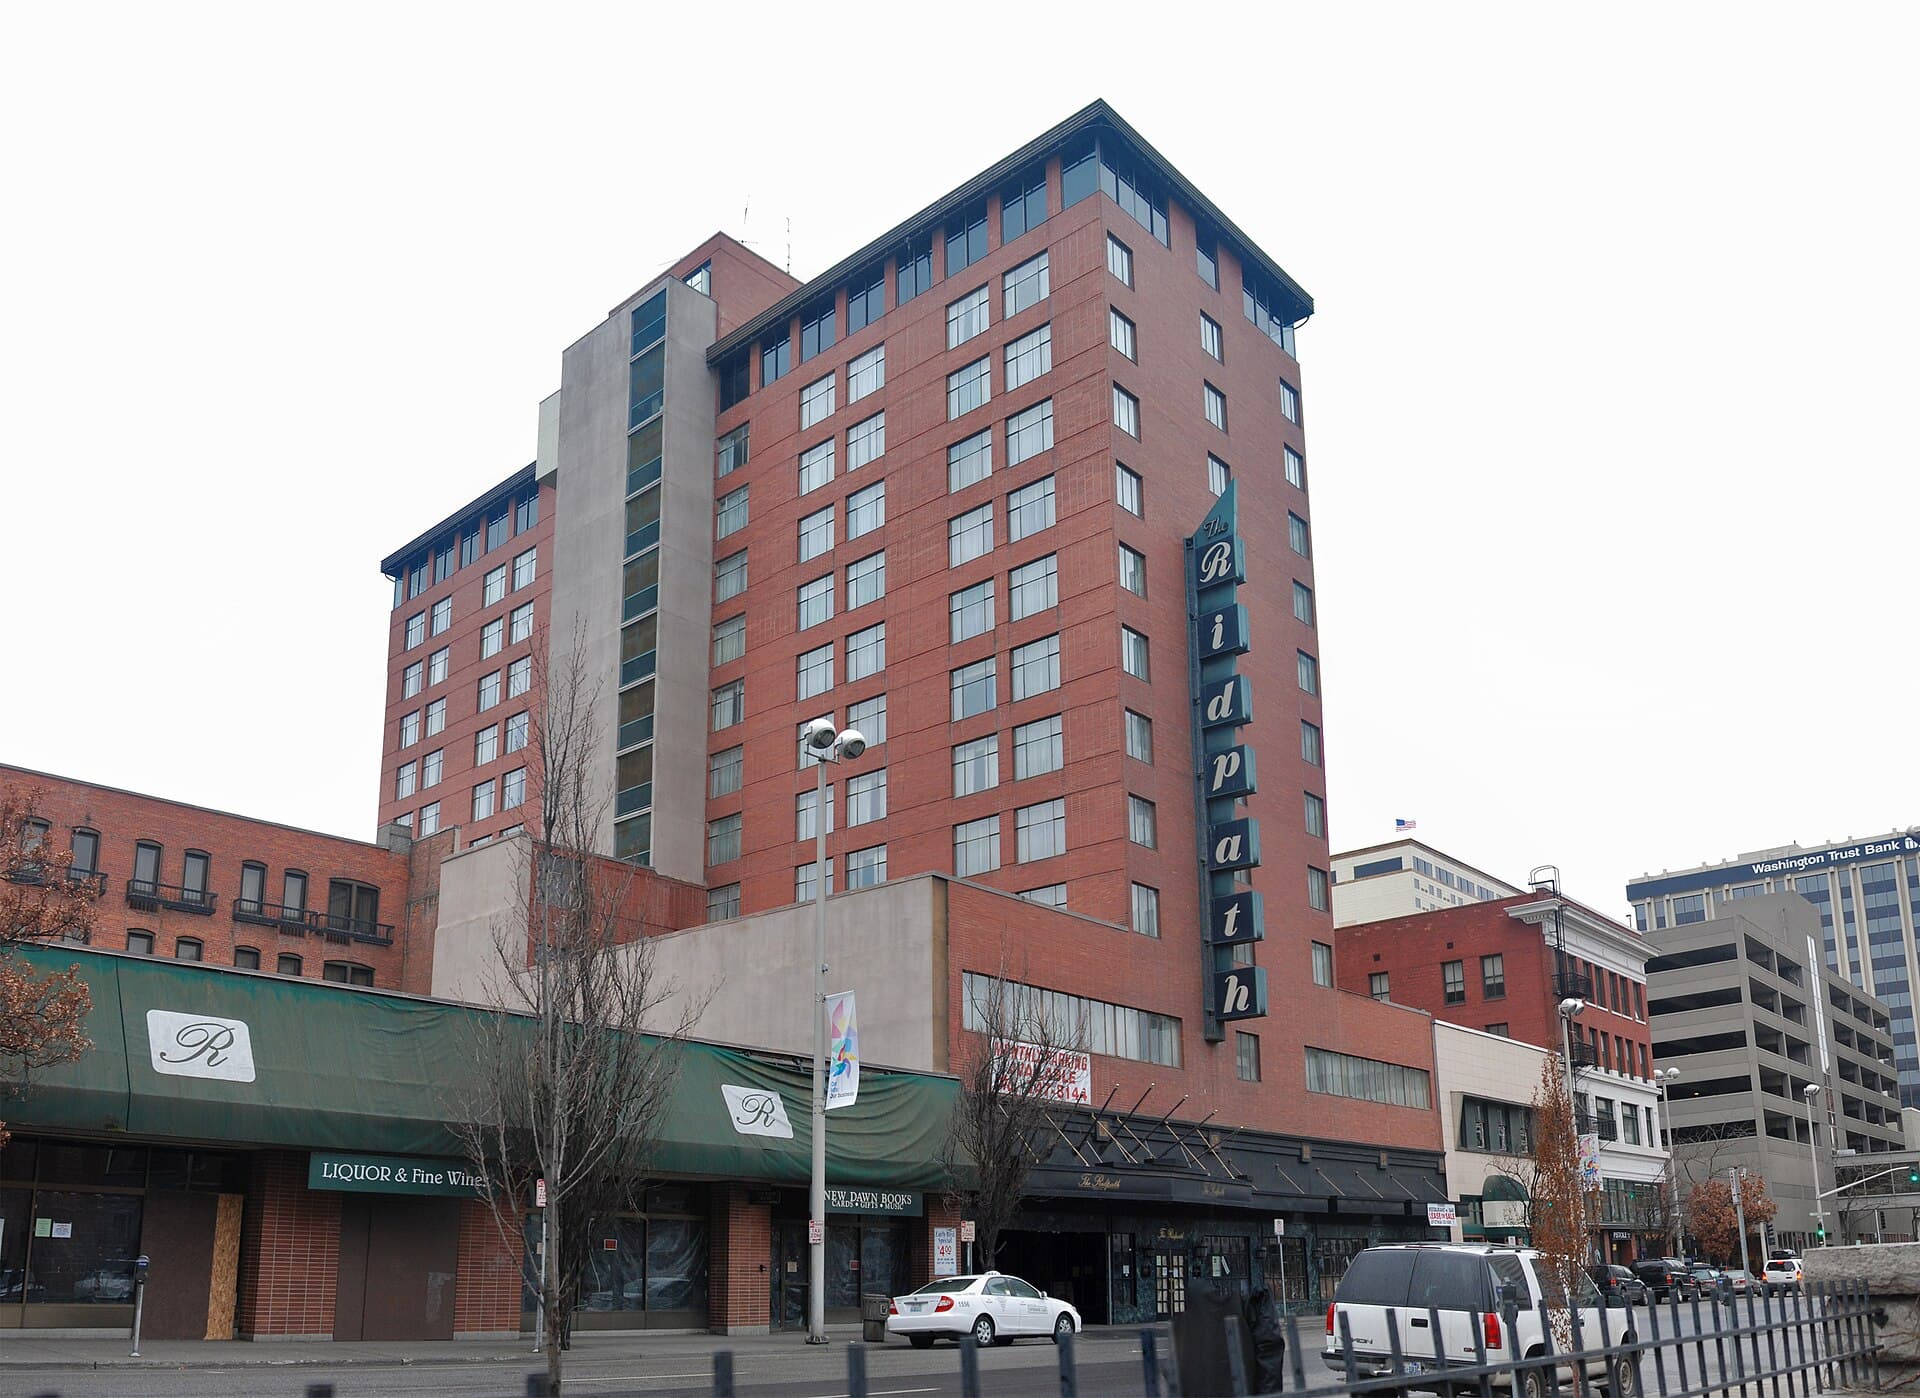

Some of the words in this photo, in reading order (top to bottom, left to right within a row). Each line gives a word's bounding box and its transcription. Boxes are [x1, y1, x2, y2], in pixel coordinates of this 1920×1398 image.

[1203, 515, 1229, 539] The
[1200, 541, 1250, 1014] Ridpath
[1752, 854, 1824, 874] Washington
[1828, 847, 1860, 861] Trust
[1865, 840, 1900, 855] Bank
[160, 1022, 235, 1067] R
[736, 1094, 775, 1127] R
[322, 1162, 391, 1182] LIQUOR
[394, 1168, 408, 1183] &
[412, 1168, 443, 1184] Fine
[823, 1190, 846, 1202] NEW
[850, 1191, 878, 1204] DAWN
[881, 1193, 912, 1205] BOOKS
[831, 1200, 854, 1208] CARDS
[860, 1201, 878, 1209] GIFTS
